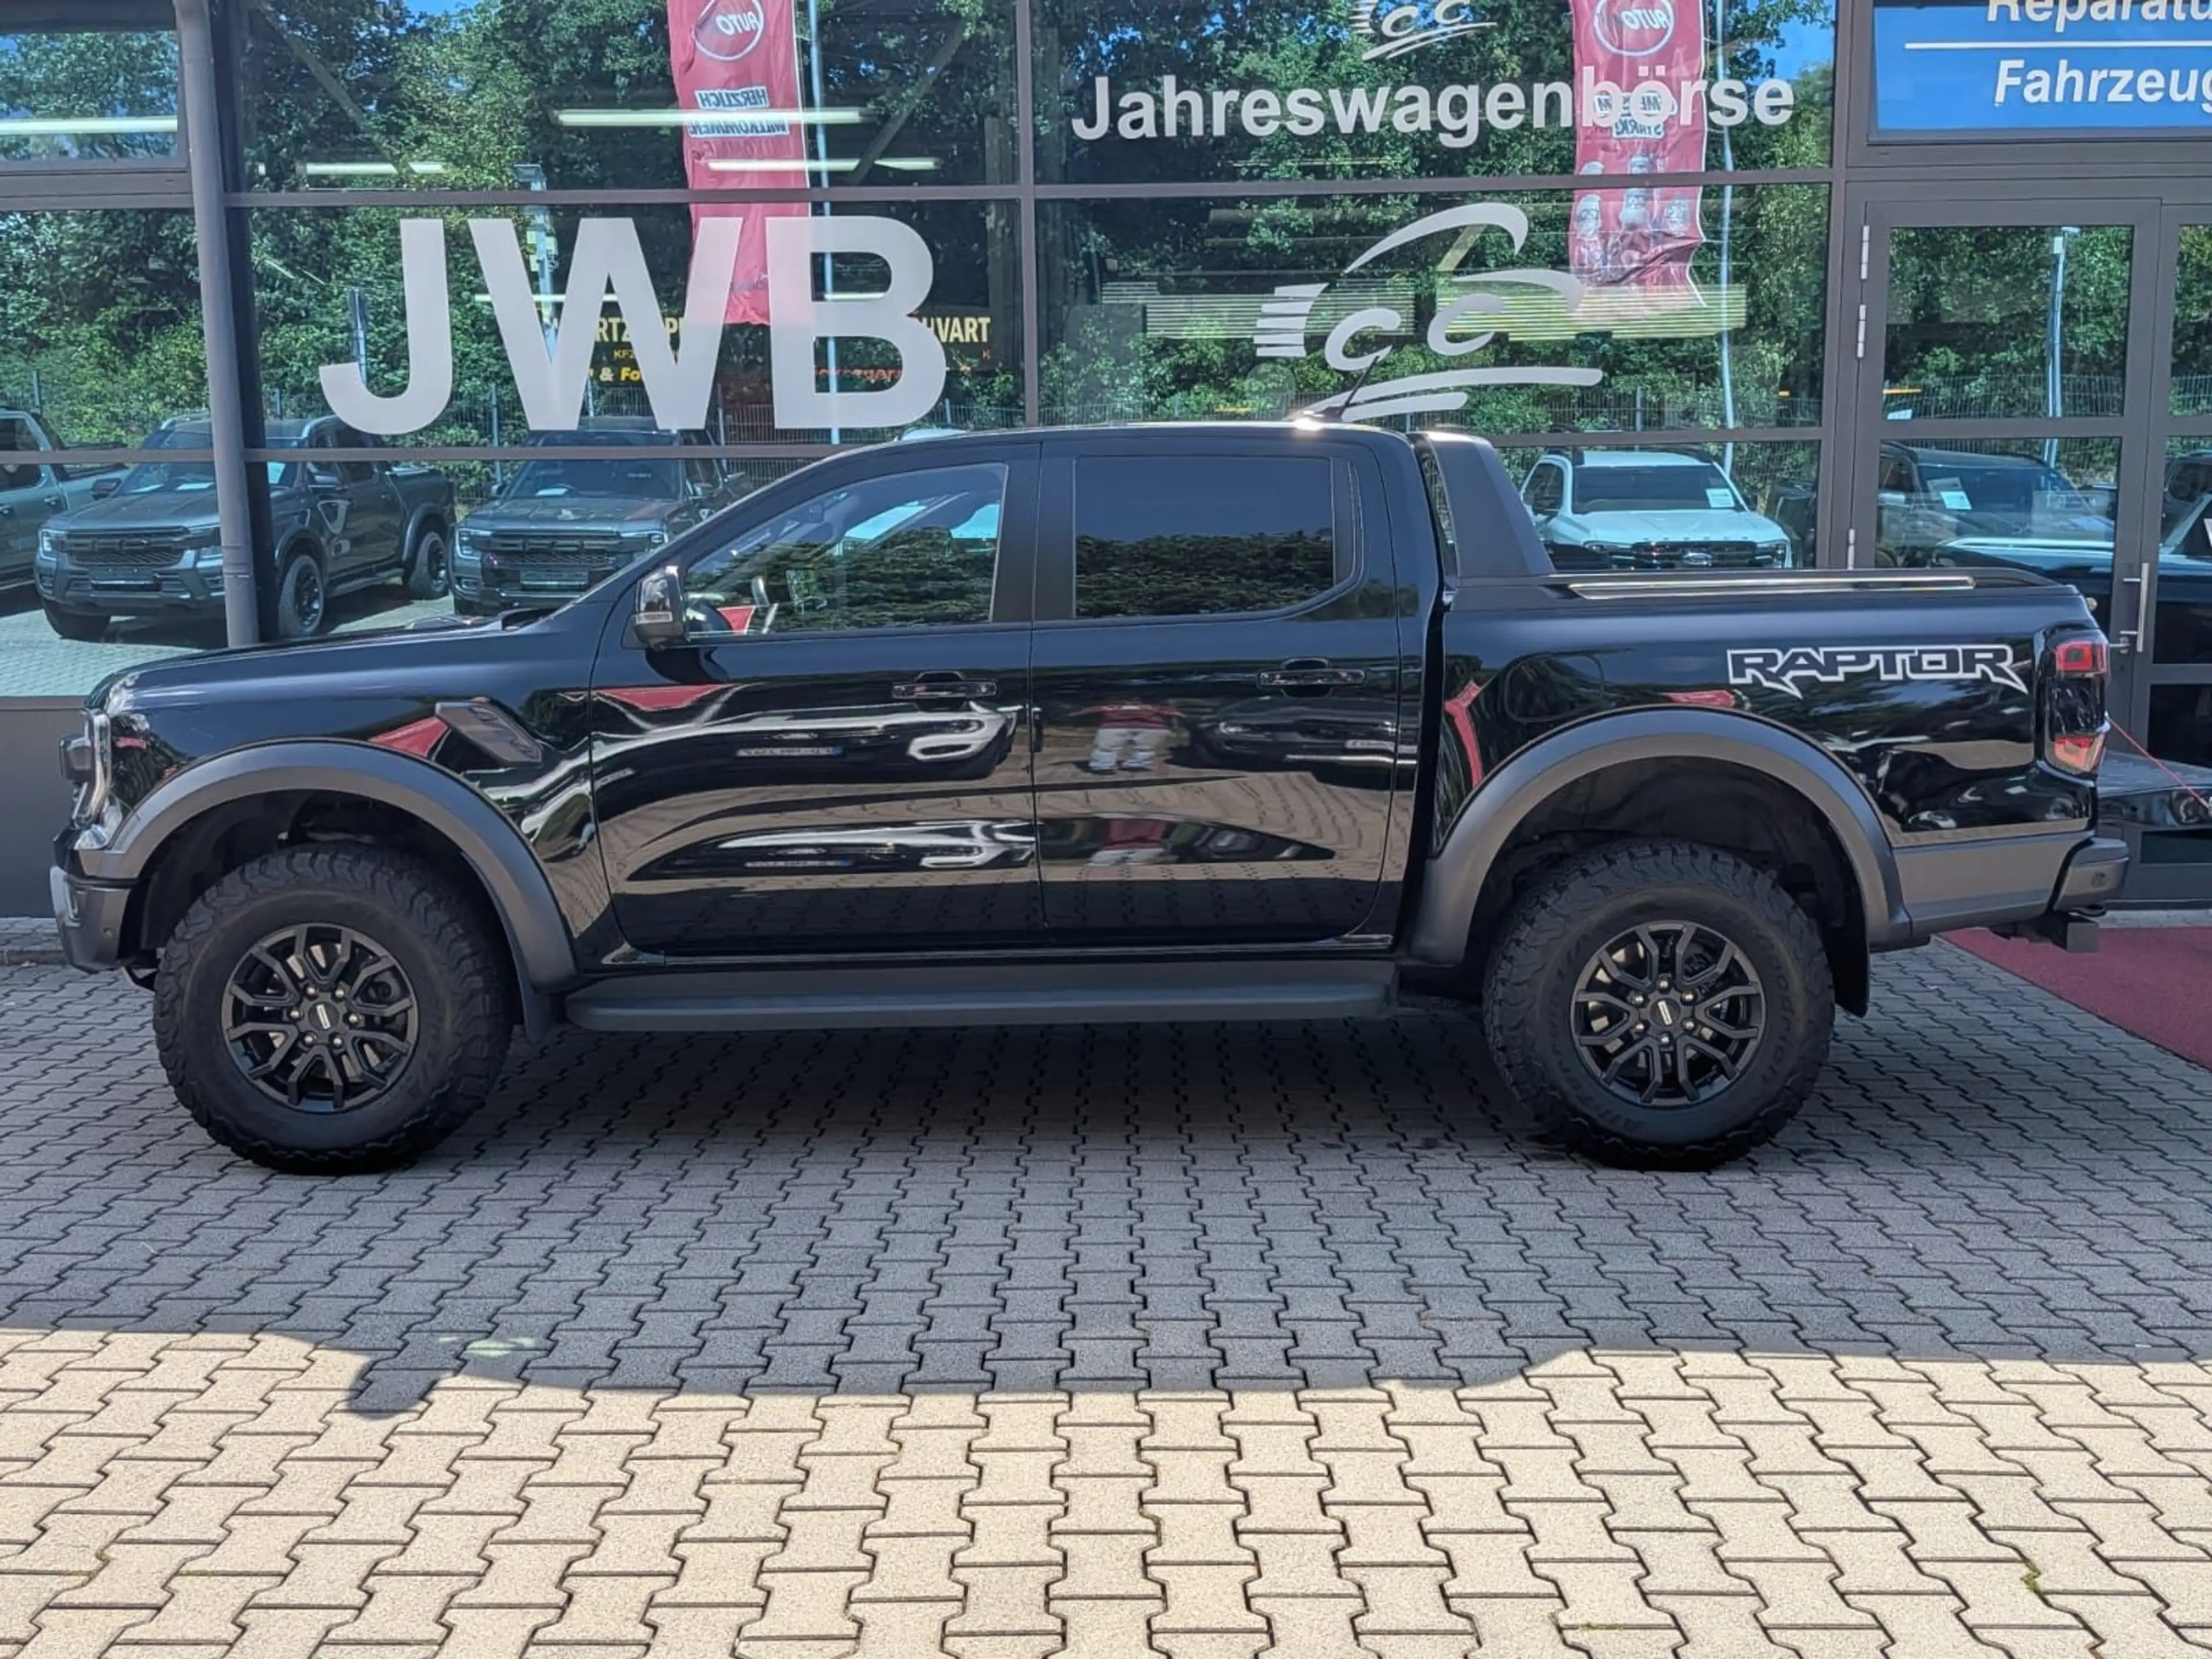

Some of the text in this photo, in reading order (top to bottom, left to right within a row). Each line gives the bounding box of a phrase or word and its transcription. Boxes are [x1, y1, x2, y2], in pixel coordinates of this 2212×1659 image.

[1071, 65, 1794, 148] Jahreswagenbörse
[319, 215, 946, 437] JWB
[1727, 644, 2029, 699] RAPTOR
